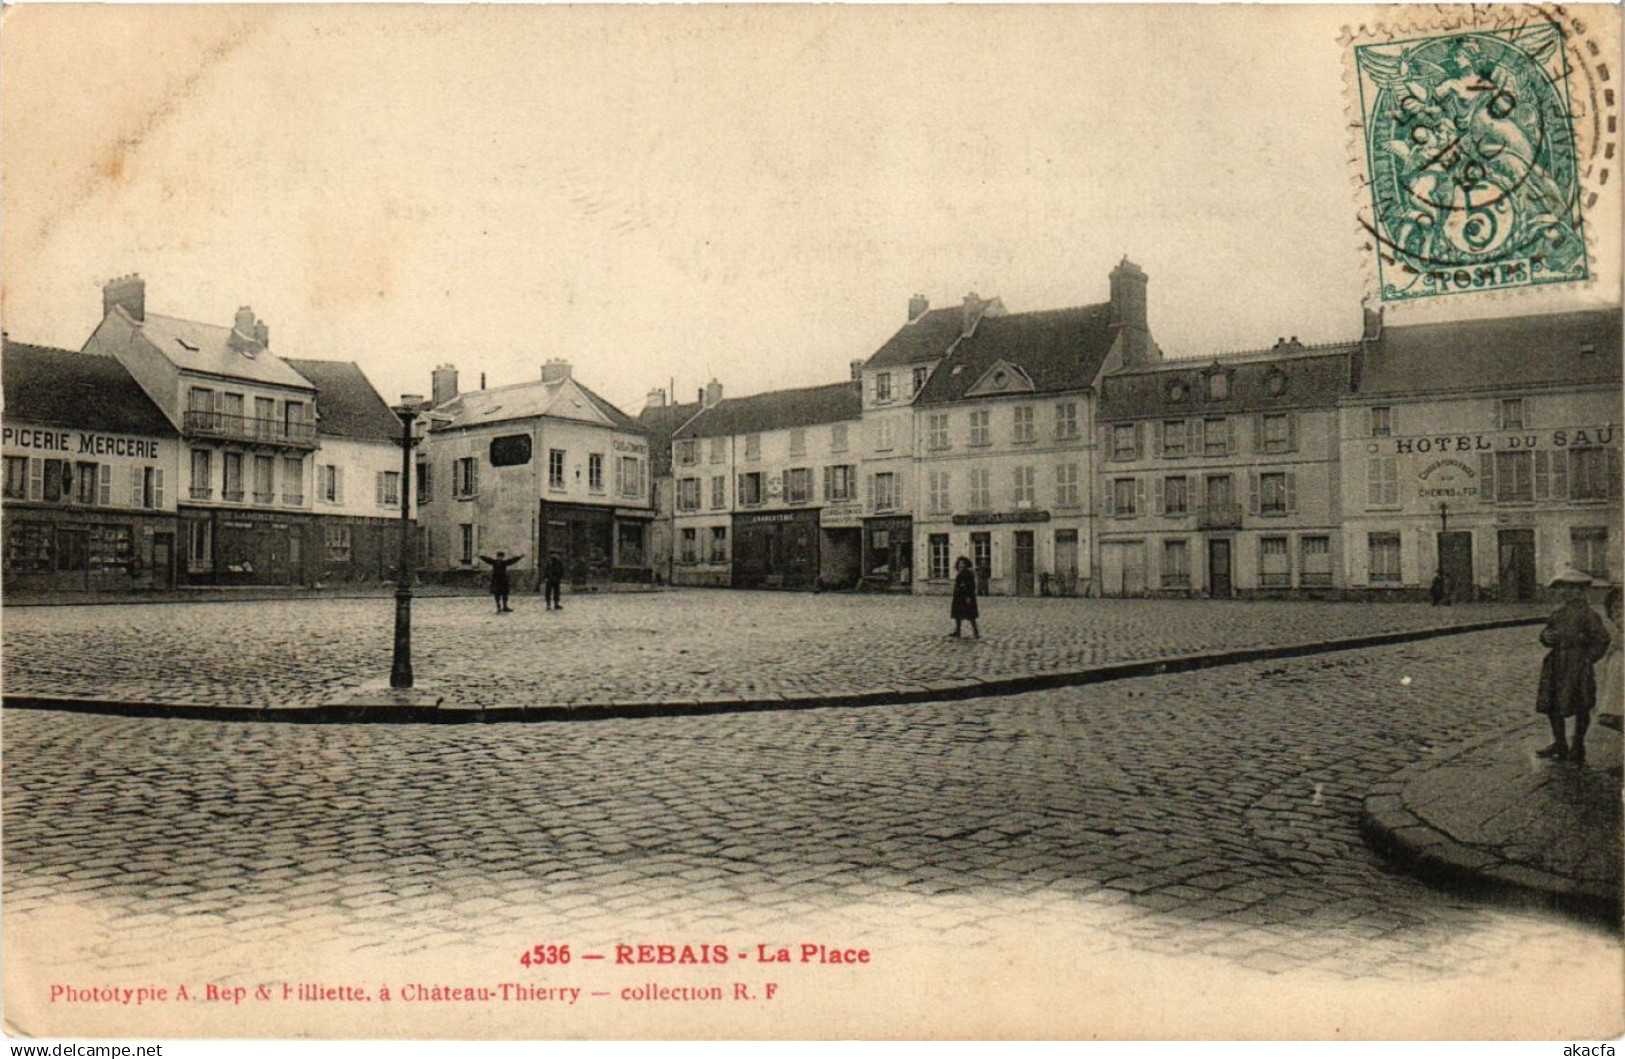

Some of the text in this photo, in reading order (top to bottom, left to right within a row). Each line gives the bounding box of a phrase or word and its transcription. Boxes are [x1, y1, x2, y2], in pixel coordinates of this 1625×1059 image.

[1460, 183, 1498, 249] 5
[1439, 261, 1528, 291] POSTES
[2, 427, 160, 459] PICERIE MERCERIE
[1396, 427, 1614, 454] HOTEL DU SAU
